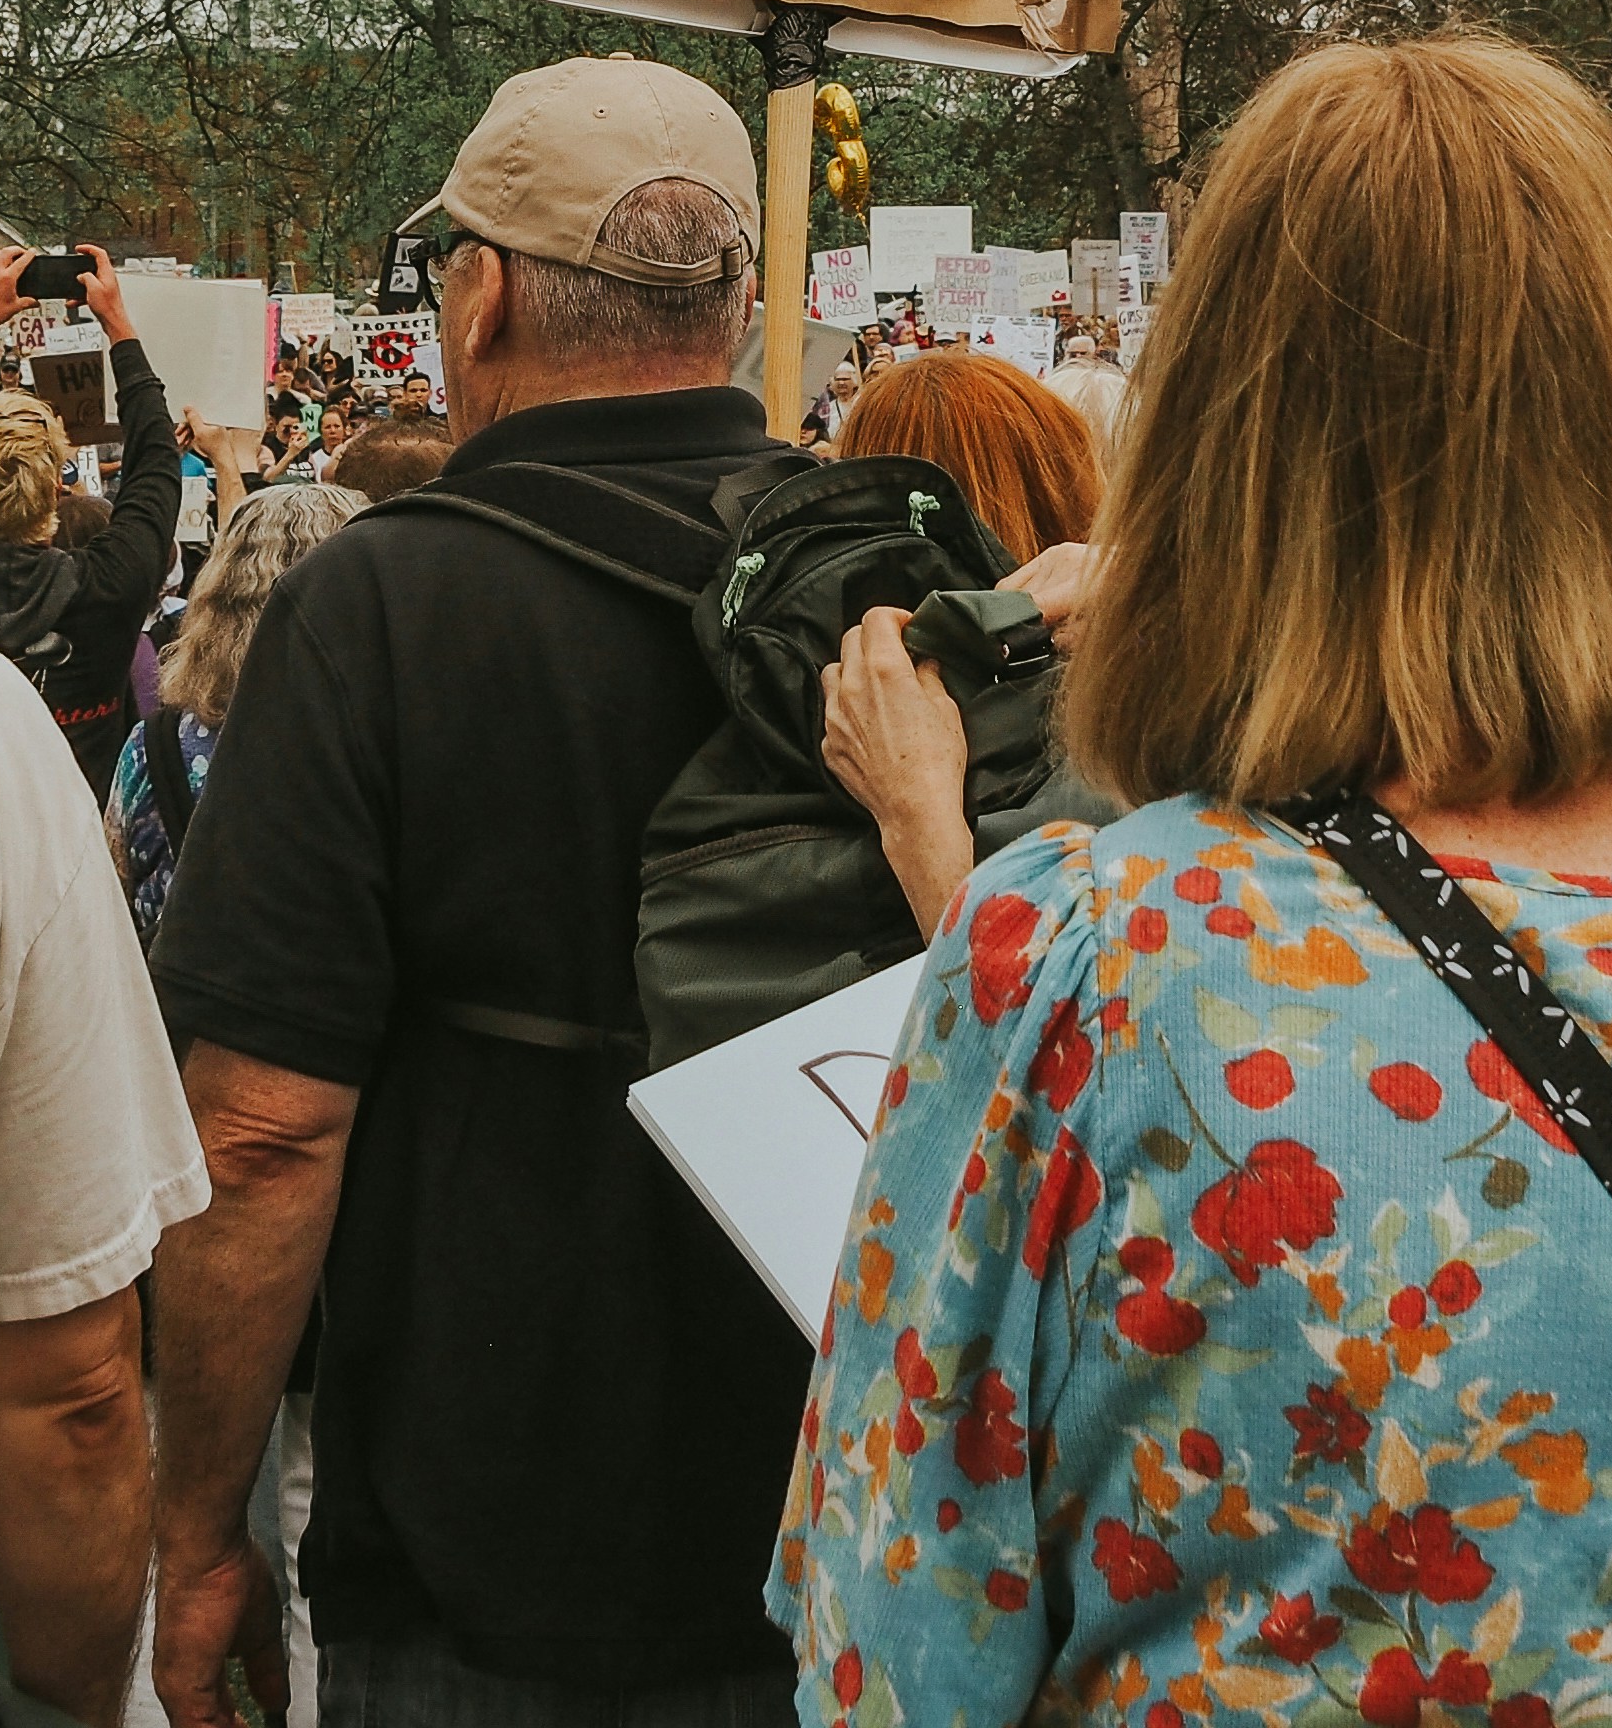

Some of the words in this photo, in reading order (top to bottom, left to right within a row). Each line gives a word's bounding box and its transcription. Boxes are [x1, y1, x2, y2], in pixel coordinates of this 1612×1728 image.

[827, 250, 852, 268] NO
[936, 257, 991, 275] DEFEND
[832, 283, 857, 301] NO
[938, 288, 986, 306] FIGHT
[20, 317, 56, 333] CAT
[352, 318, 431, 331] PROTECT
